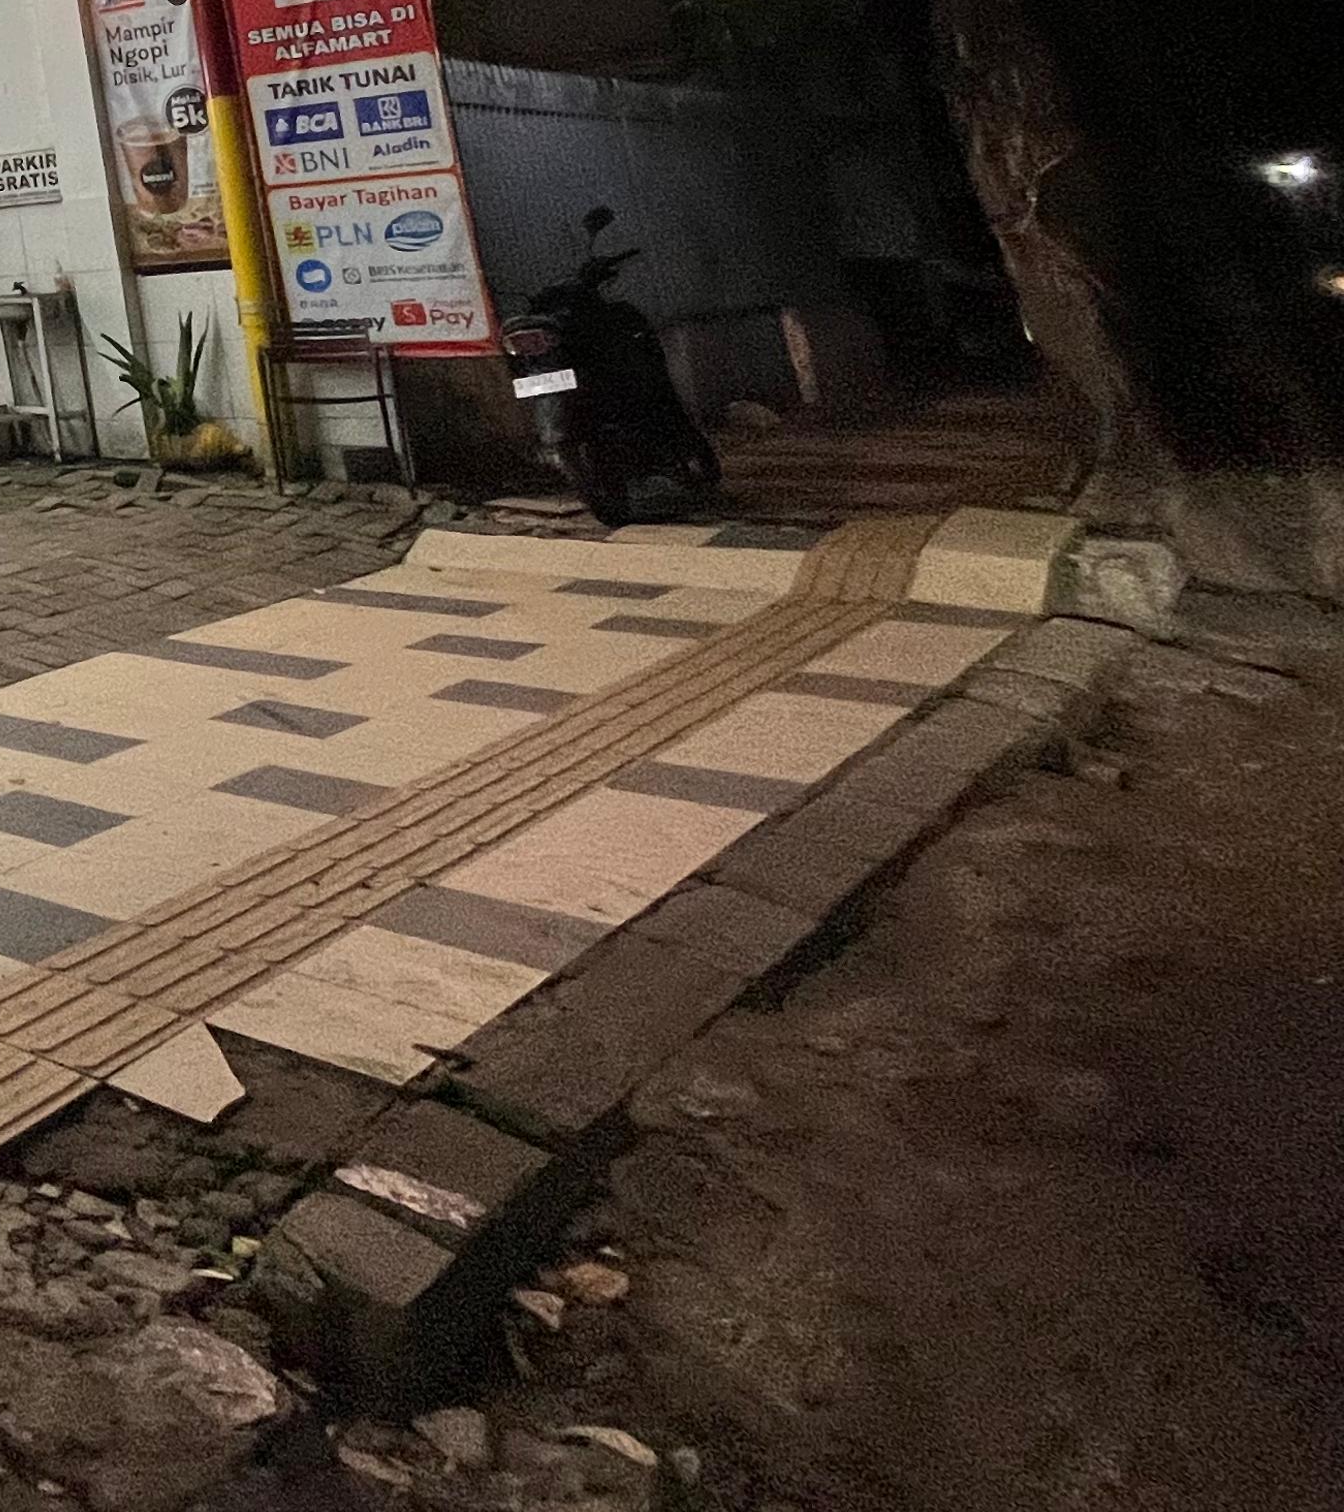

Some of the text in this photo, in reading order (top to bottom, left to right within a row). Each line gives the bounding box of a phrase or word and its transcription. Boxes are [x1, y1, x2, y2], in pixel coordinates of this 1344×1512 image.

[105, 19, 175, 45] Mampir
[248, 4, 415, 46] SEMUA BISA DI
[109, 41, 169, 68] Ngopi
[275, 29, 391, 62] ALFAMART
[112, 63, 186, 87] Disik, Lur
[268, 64, 416, 101] TARIK TUNAI
[172, 104, 207, 128] 5k
[296, 110, 339, 135] BCA
[373, 136, 430, 157] Aladin
[301, 148, 351, 174] BNI
[289, 184, 438, 213] Bayar Tagihan
[316, 223, 373, 248] PLN
[429, 308, 474, 328] Pay
